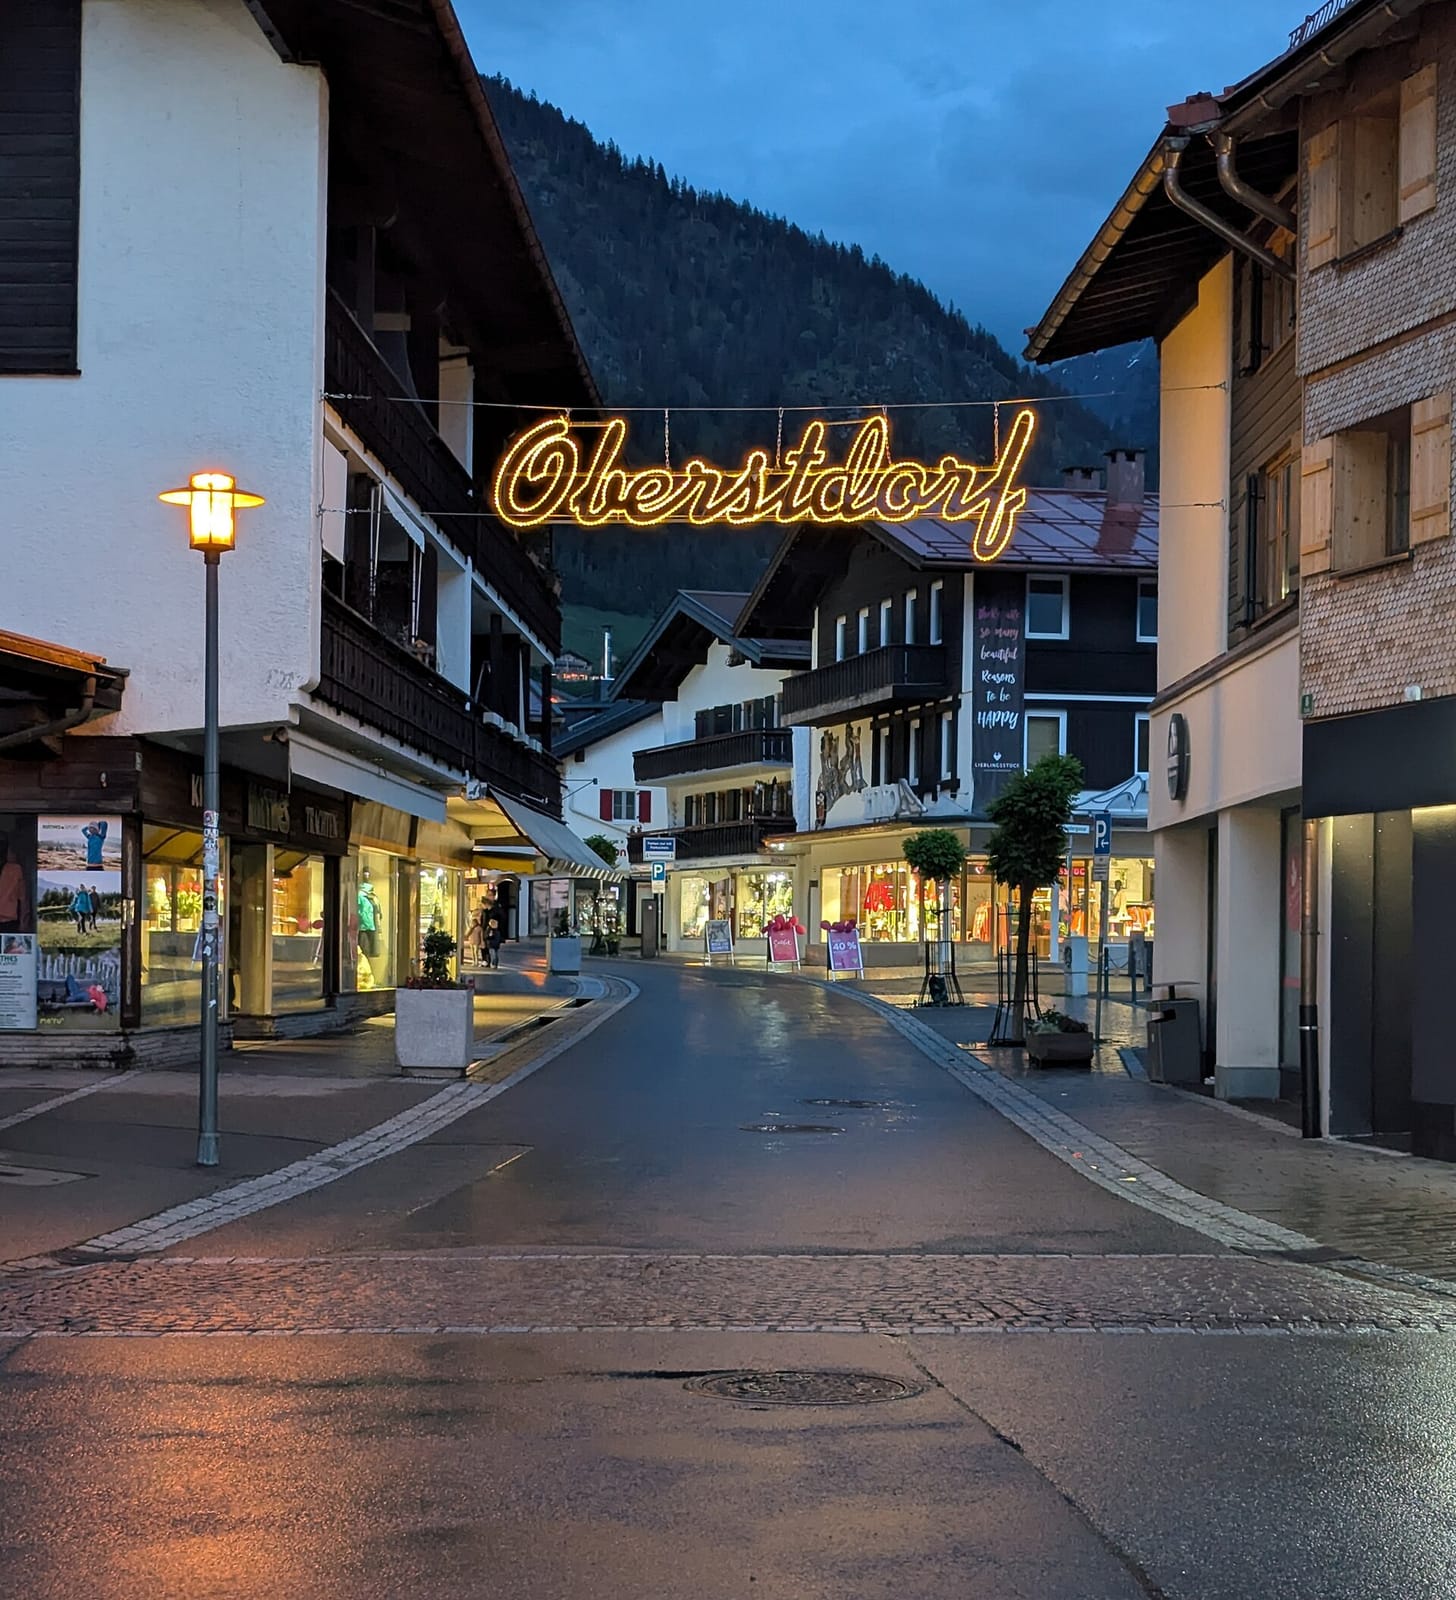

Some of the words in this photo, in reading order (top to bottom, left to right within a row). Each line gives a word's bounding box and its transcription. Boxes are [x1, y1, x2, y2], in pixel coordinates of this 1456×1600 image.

[494, 409, 1034, 561] Oberstdorf
[980, 627, 991, 639] so
[994, 627, 1019, 641] many
[980, 645, 1018, 664] beautiful
[981, 669, 1016, 685] Reasons
[999, 686, 1011, 702] be
[977, 709, 1019, 730] HAPPY
[1095, 820, 1107, 848] P
[653, 864, 664, 878] P
[832, 942, 846, 951] 40
[846, 941, 857, 950] %
